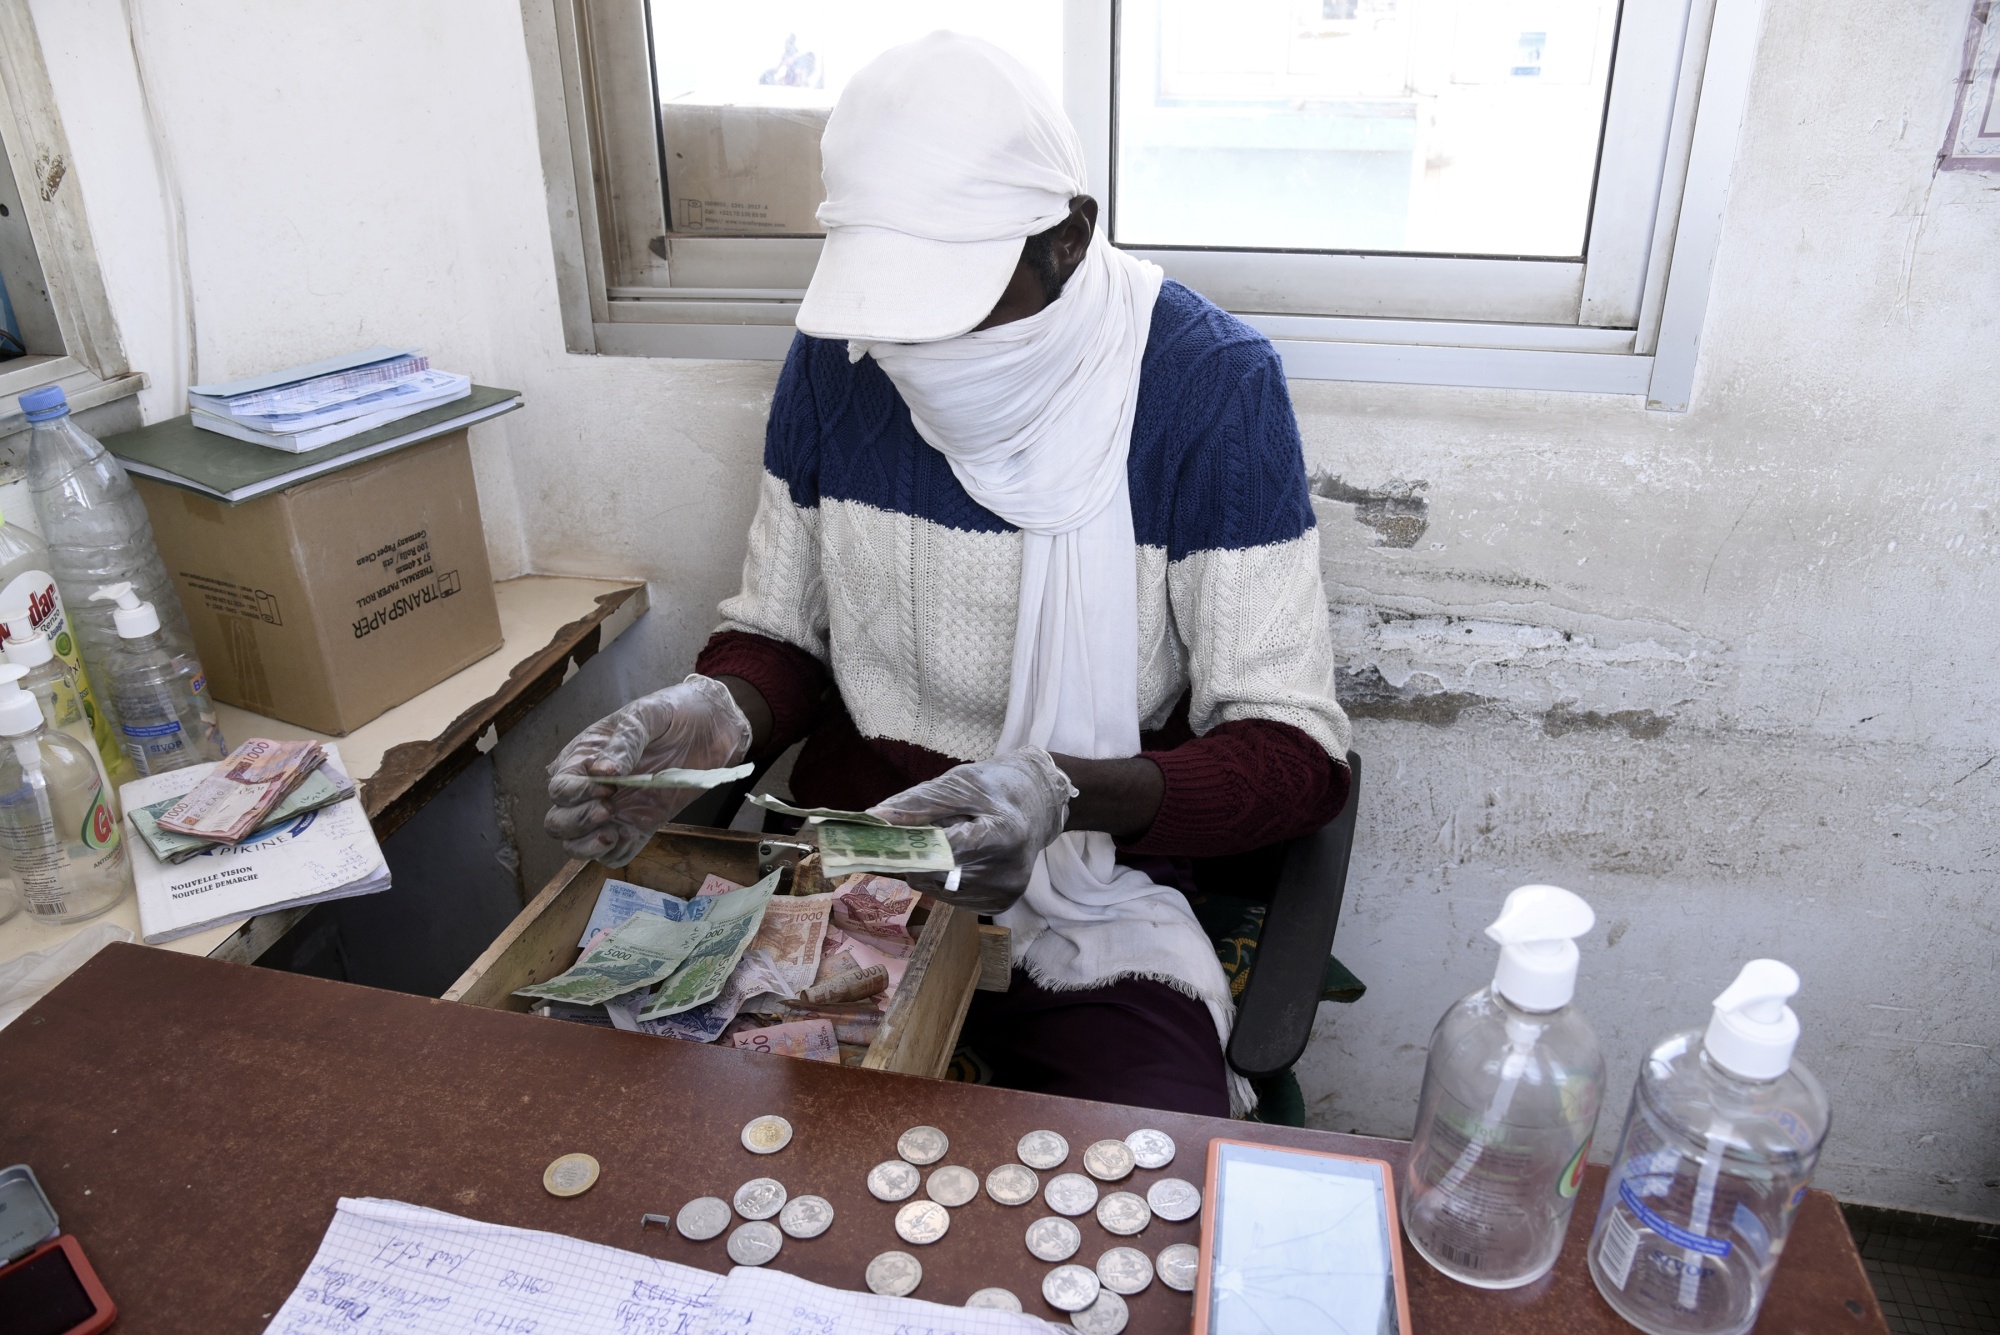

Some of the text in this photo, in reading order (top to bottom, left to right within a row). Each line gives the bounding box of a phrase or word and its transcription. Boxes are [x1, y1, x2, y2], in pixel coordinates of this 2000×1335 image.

[356, 530, 427, 566] Germany Paper Clean
[417, 541, 428, 552] 100
[423, 552, 431, 561] 57
[395, 560, 416, 574] 40mm
[356, 565, 434, 608] THERMAL PAPER ROLL
[352, 583, 439, 639] TRANSPAPER
[150, 740, 182, 753] SIVOP
[243, 741, 270, 763] 1000
[163, 802, 189, 820] 1000
[219, 835, 289, 856] PIKINE
[170, 866, 253, 892] NOUVELLE VISION
[172, 873, 259, 900] NOUVELLE DEMARCHE
[795, 912, 823, 922] 1000
[604, 948, 632, 961] 5000
[853, 964, 883, 981] 1000
[1650, 1250, 1715, 1280] SIVOP
